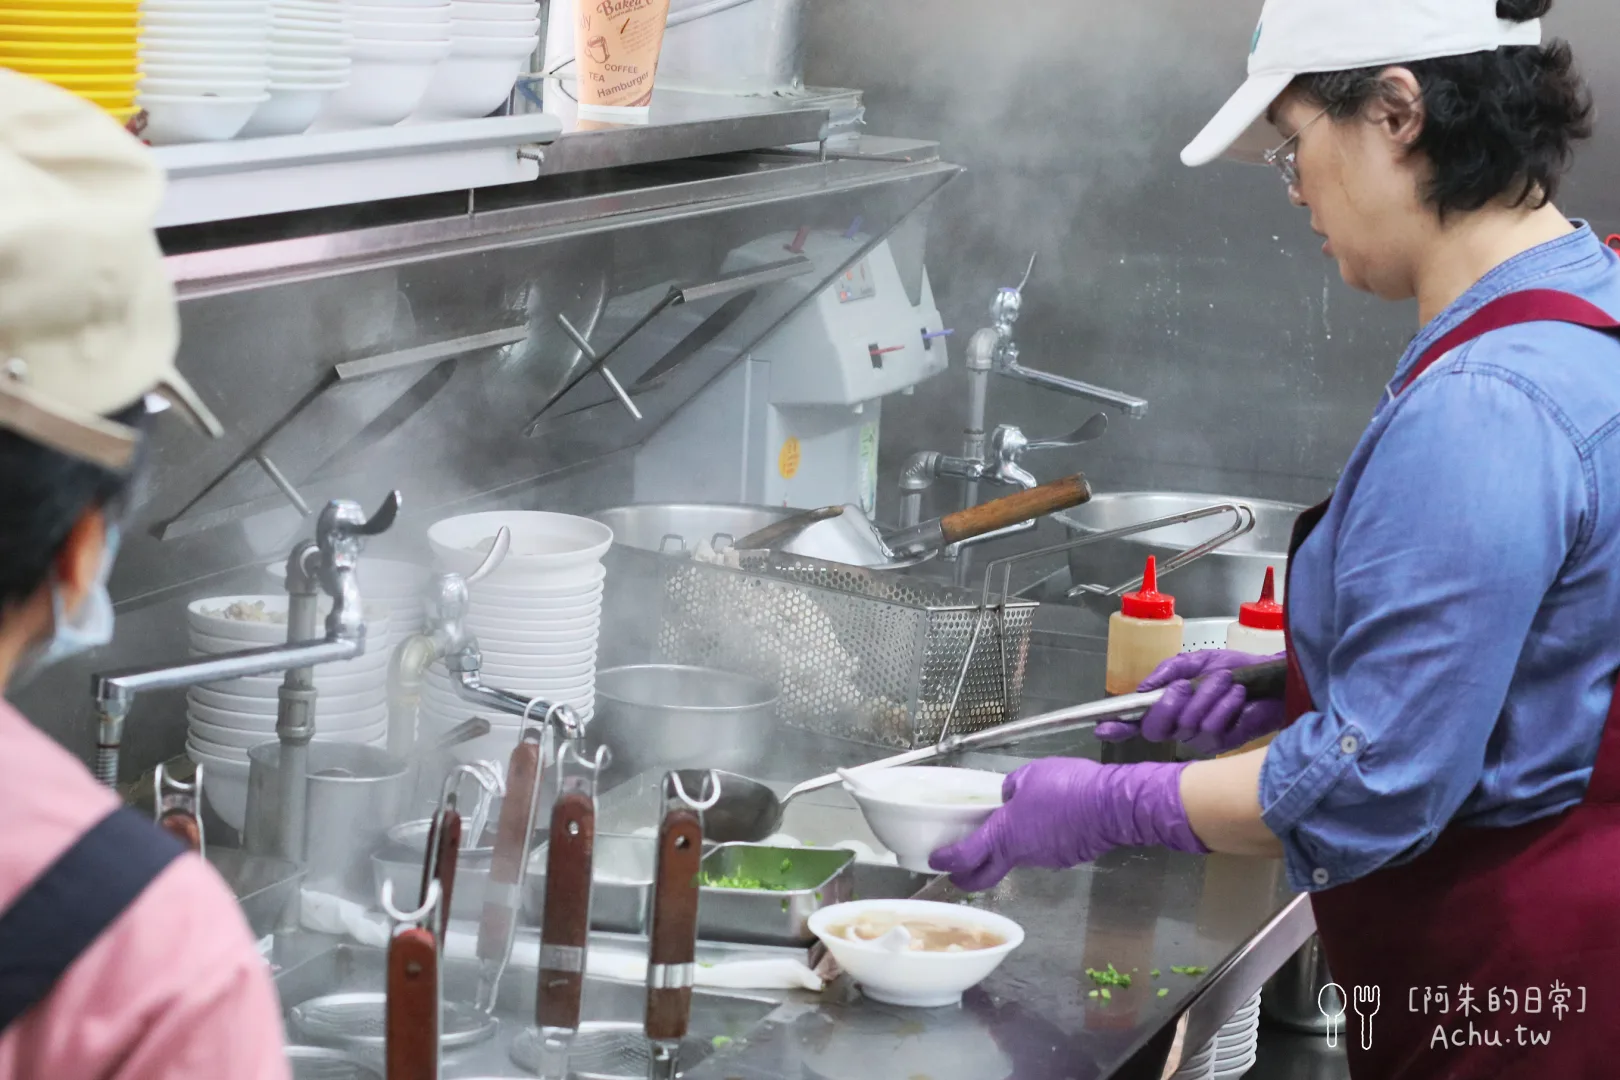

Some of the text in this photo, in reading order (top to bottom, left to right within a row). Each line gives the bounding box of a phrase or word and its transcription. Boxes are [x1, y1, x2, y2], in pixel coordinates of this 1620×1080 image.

[604, 63, 639, 74] COFFEE
[588, 71, 606, 83] TEA
[596, 71, 650, 98] Hamburger
